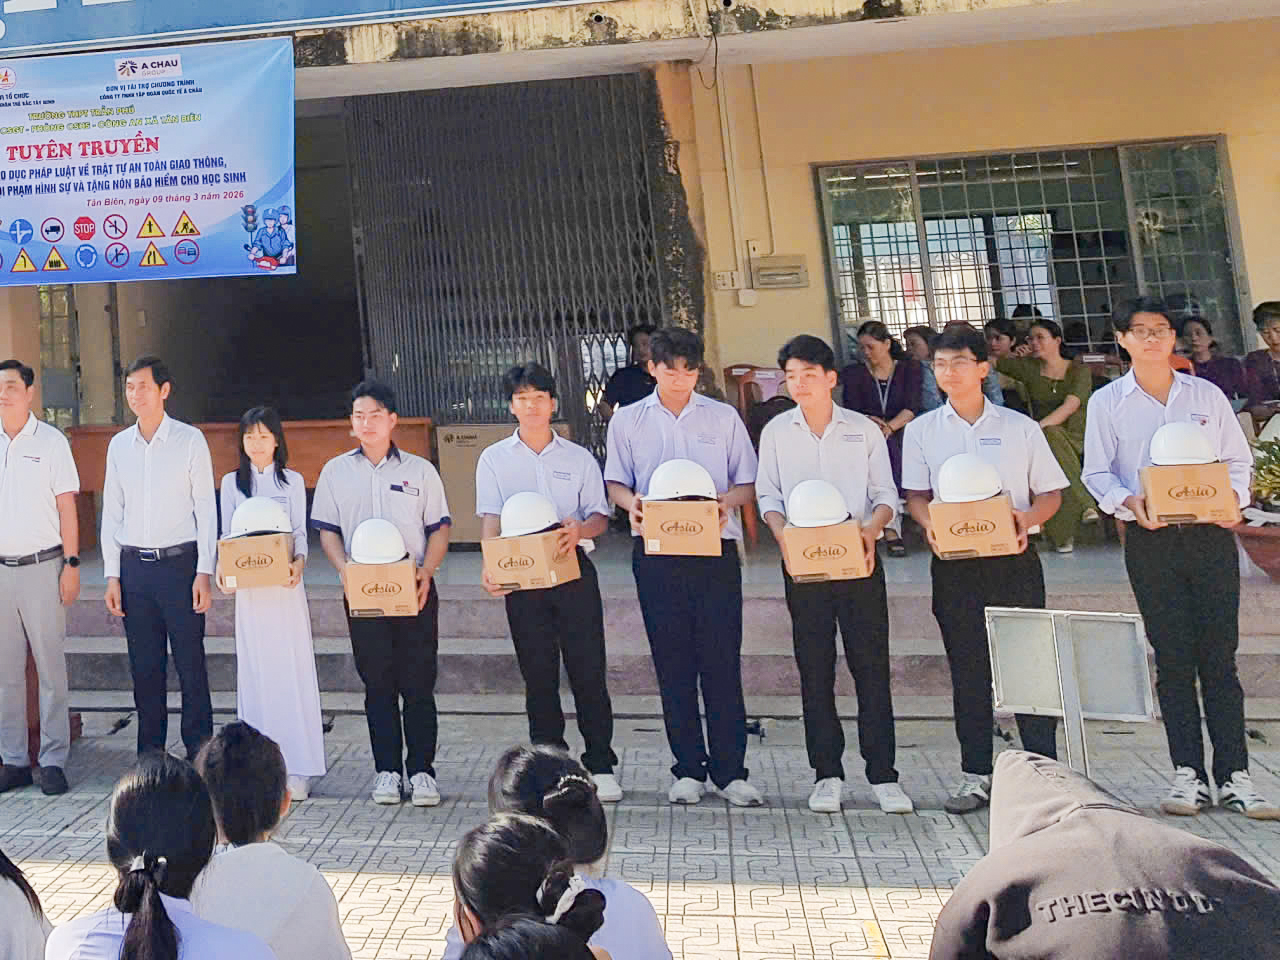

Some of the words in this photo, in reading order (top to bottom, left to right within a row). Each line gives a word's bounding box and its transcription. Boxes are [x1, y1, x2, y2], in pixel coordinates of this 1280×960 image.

[150, 60, 178, 69] CHAU
[6, 139, 72, 160] TUYÊN
[78, 130, 159, 157] TRUYỀN
[8, 169, 27, 182] DỤC
[29, 167, 52, 179] PHÁP
[55, 165, 76, 179] LUẬT
[92, 163, 113, 177] TRẬT
[115, 163, 127, 176] TỰ
[128, 162, 141, 173] AN
[144, 159, 167, 171] TOÀN
[169, 158, 190, 170] GIAO
[193, 155, 227, 169] THÔNG,
[7, 184, 32, 197] PHẠM
[35, 182, 56, 194] HÌNH
[58, 181, 71, 195] SỰ
[73, 180, 85, 193] VÀ
[87, 180, 110, 193] TẶNG
[113, 177, 131, 190] NÓN
[134, 175, 152, 188] BẢO
[154, 172, 178, 187] HIỂM
[180, 174, 199, 185] CHO
[202, 173, 221, 186] HỌC
[223, 171, 246, 183] SINH
[87, 199, 101, 207] Tân
[129, 196, 150, 206] ngày
[153, 195, 163, 203] 09
[165, 194, 191, 203] tháng
[193, 192, 199, 200] 3
[201, 192, 220, 200] năm
[223, 190, 244, 199] 2026
[74, 223, 95, 234] STOP
[1175, 486, 1209, 497] Asia
[667, 521, 696, 532] Asia
[957, 522, 988, 534] Asia
[810, 546, 841, 558] Asia
[241, 556, 267, 567] Asia
[503, 557, 529, 568] Asia
[368, 583, 396, 593] Asia
